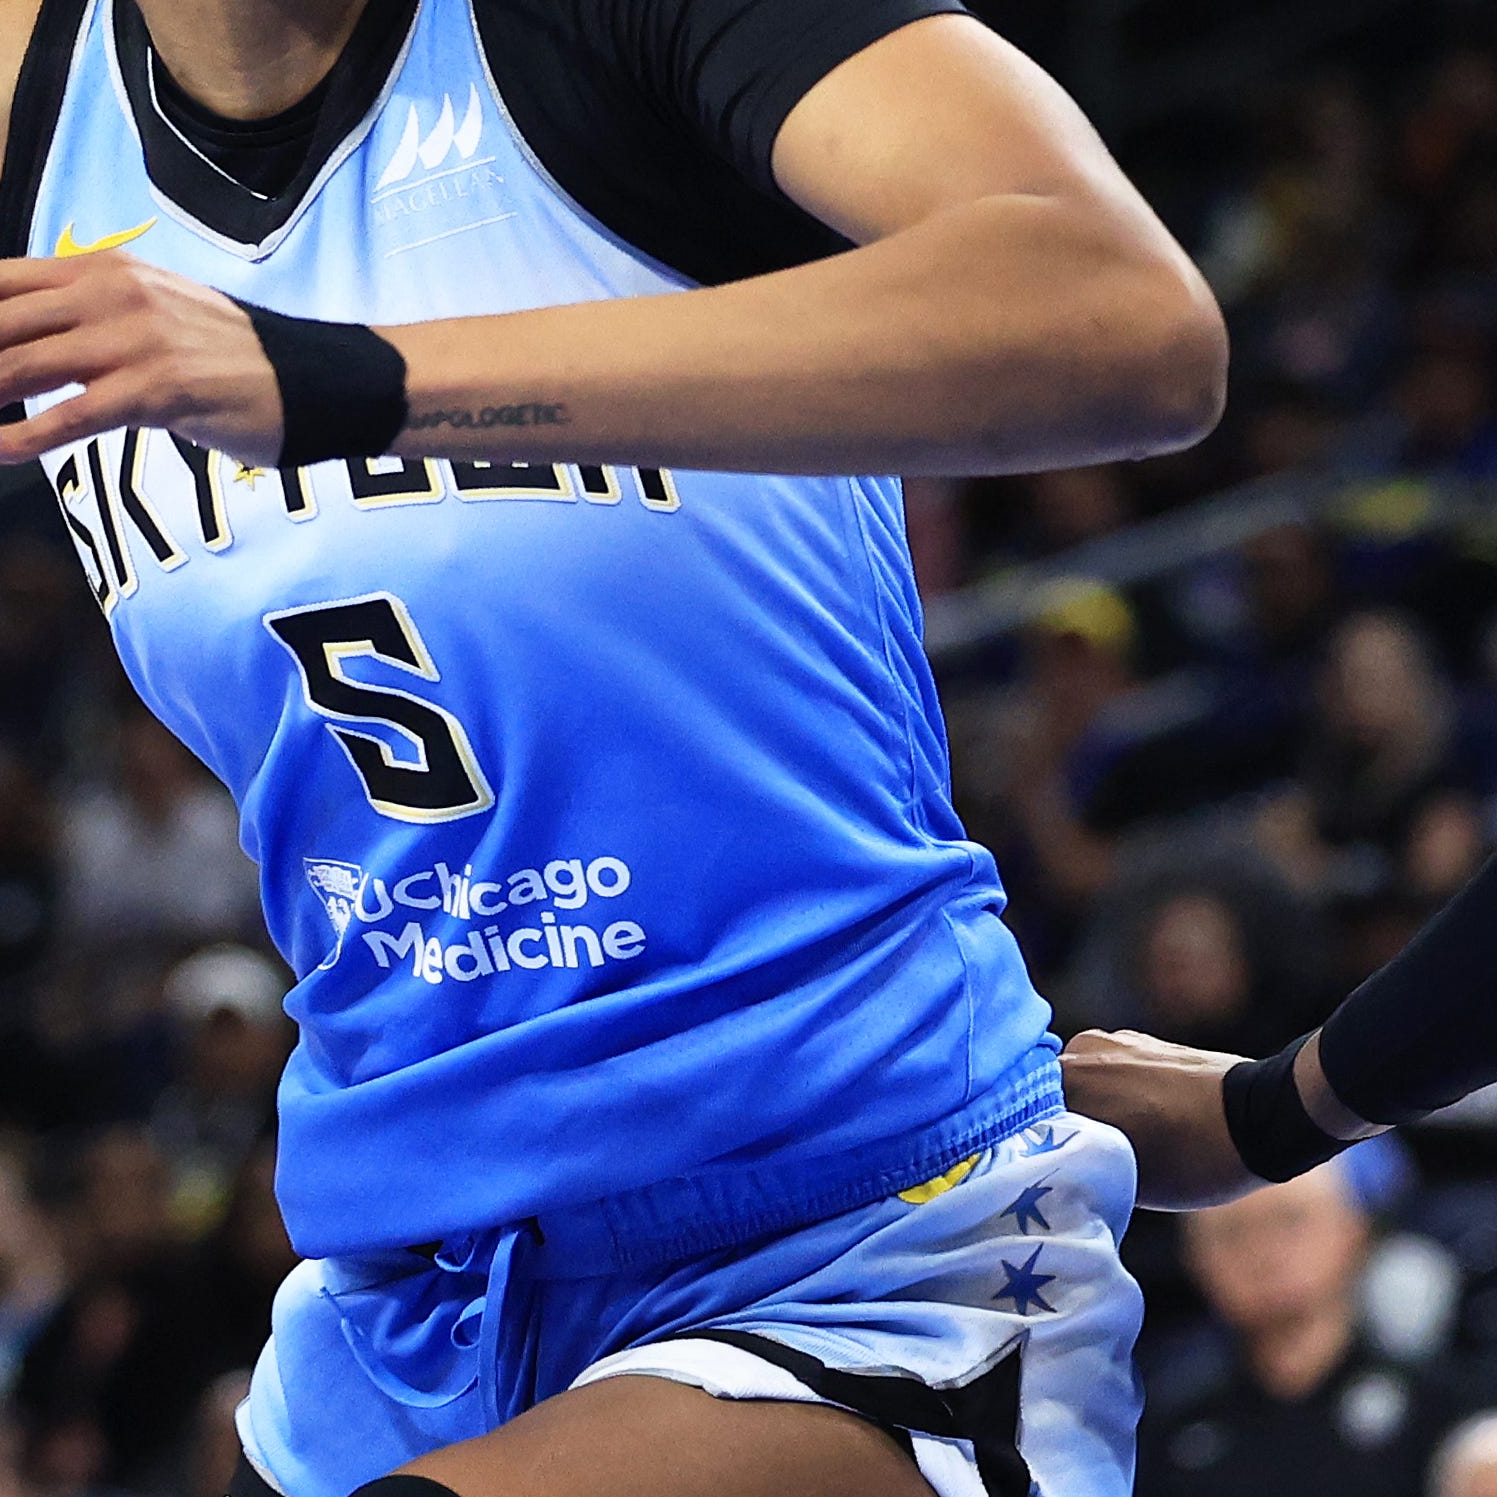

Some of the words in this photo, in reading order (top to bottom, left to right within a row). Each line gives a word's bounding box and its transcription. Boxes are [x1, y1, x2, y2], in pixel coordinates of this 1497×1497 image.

[262, 591, 495, 824] 5
[355, 856, 631, 923] UChicago
[362, 911, 647, 984] Medicine
